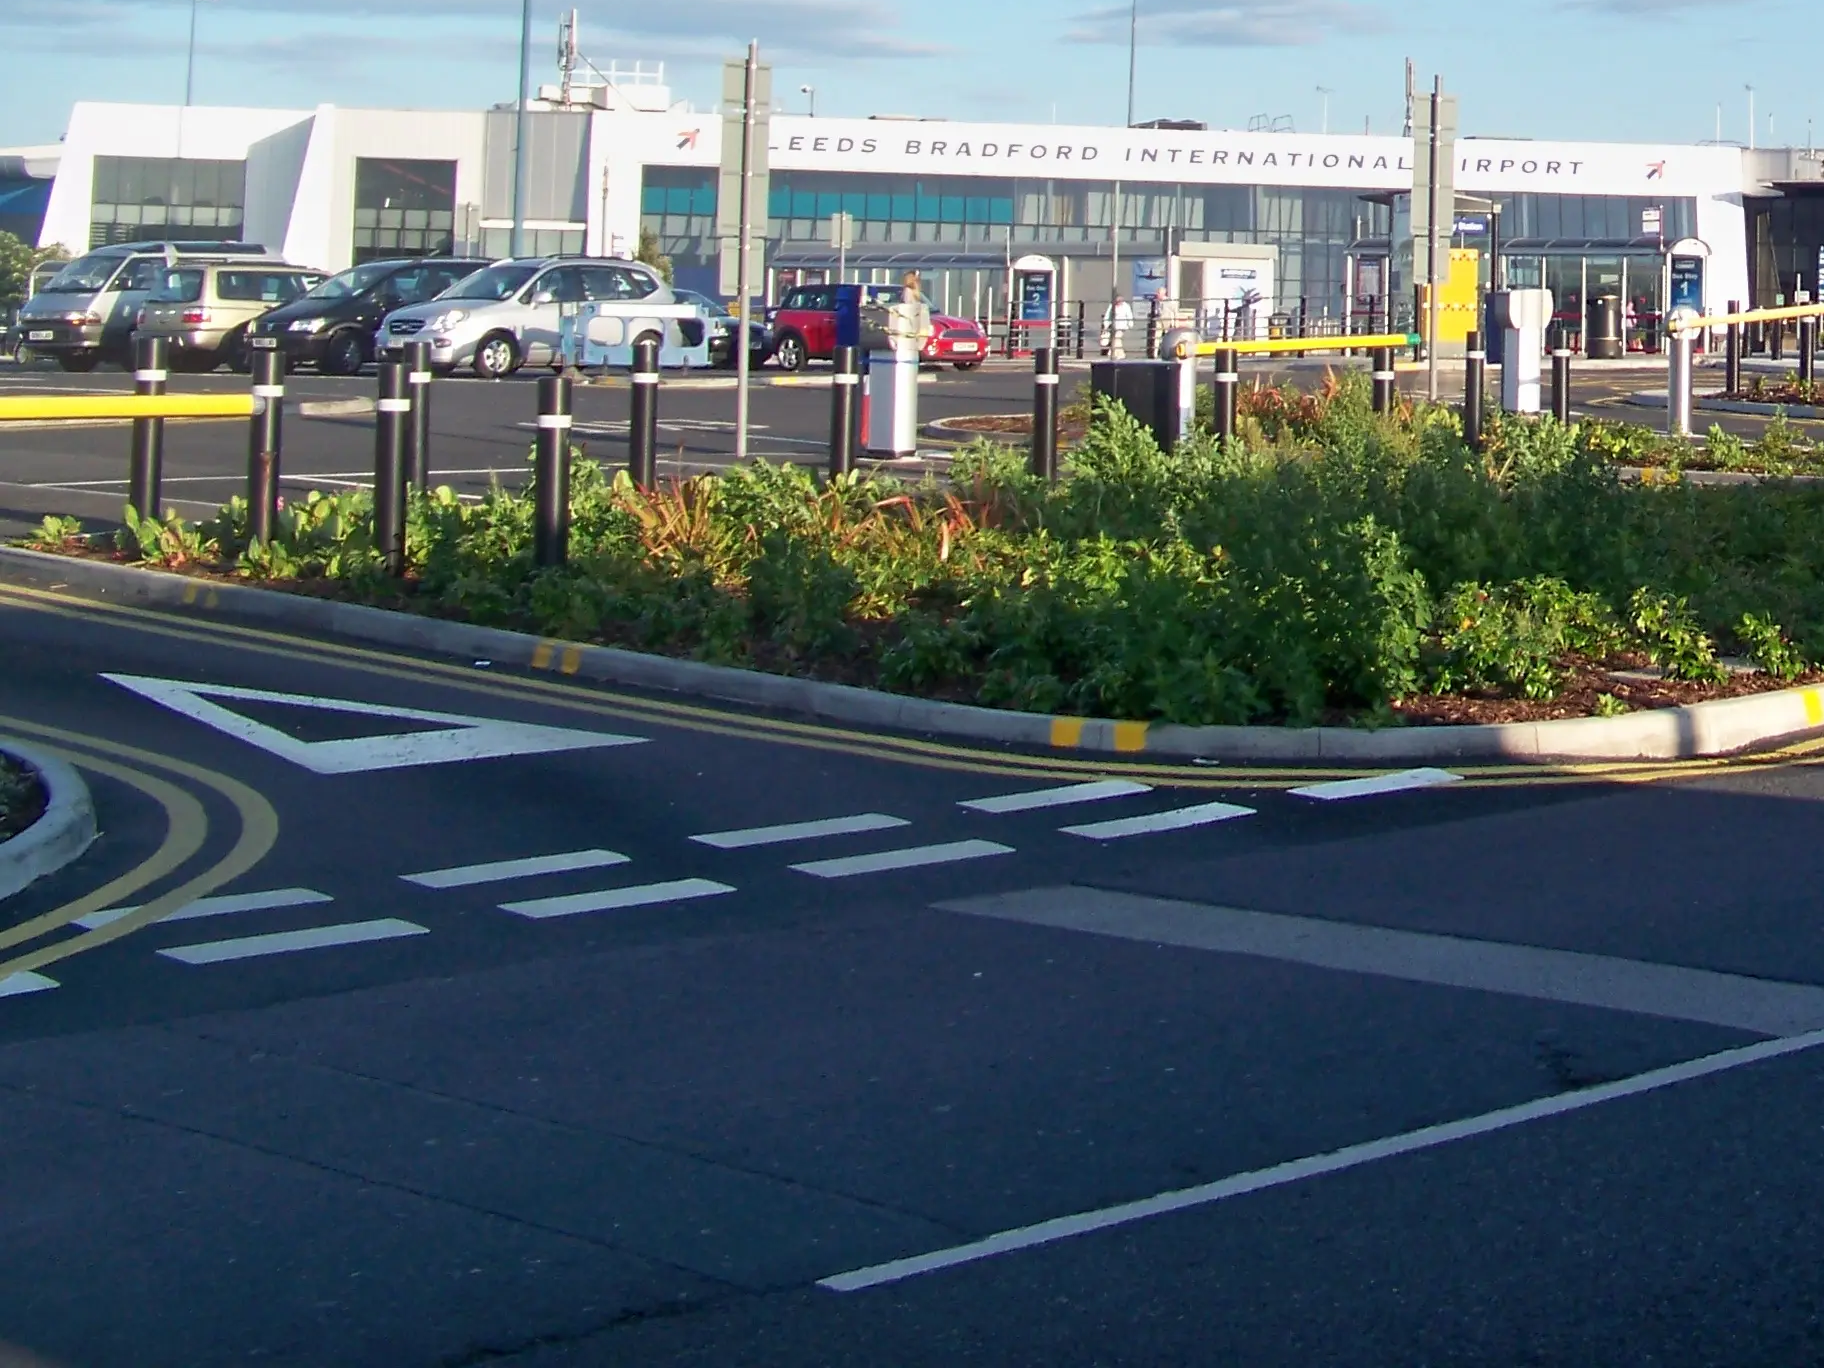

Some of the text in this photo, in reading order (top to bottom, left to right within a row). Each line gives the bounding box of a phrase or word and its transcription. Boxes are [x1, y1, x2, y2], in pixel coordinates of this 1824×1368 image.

[905, 140, 1098, 161] BRADFORD
[1125, 147, 1414, 170] INTERNATIONAL
[1462, 158, 1584, 175] IRPORT
[1680, 281, 1688, 296] 1
[1032, 292, 1040, 306] 2
